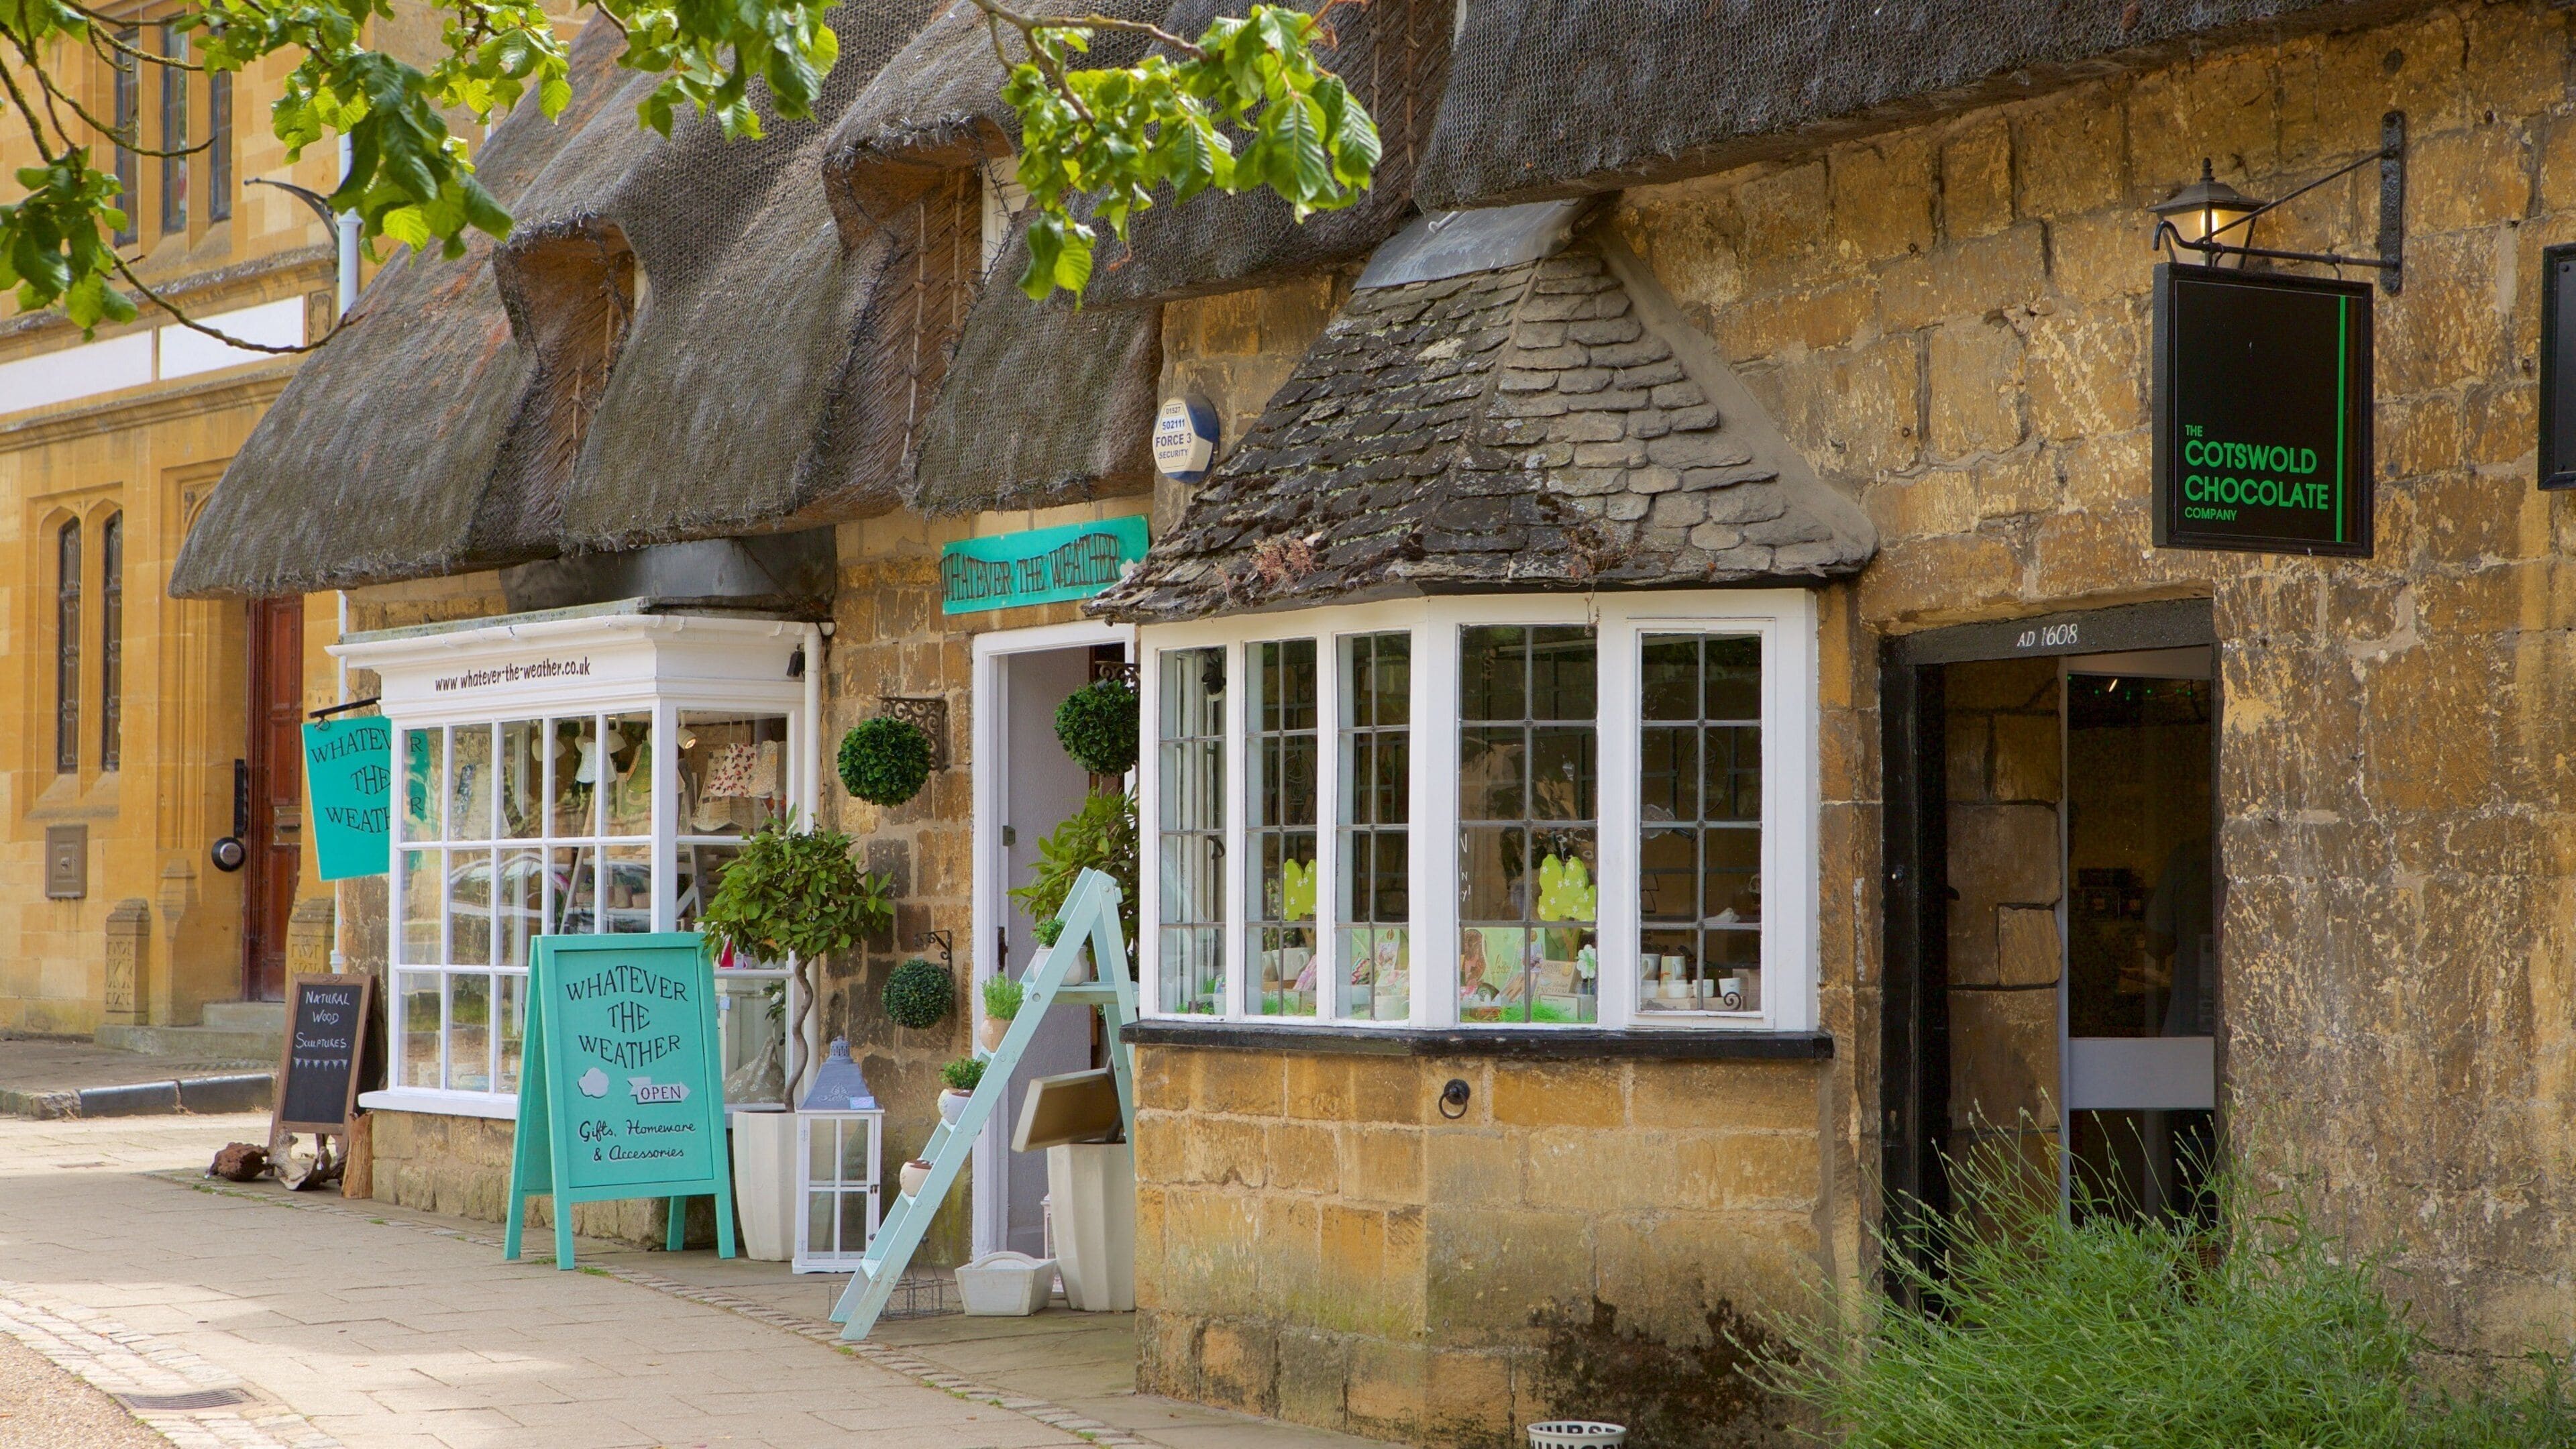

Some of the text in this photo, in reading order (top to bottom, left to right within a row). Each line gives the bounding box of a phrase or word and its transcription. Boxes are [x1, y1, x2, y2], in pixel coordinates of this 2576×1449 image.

[1162, 419, 1185, 430] 502111
[2185, 425, 2203, 437] THE
[1155, 433, 1191, 447] FORCE 3
[1159, 449, 1188, 460] SECURITY
[2184, 439, 2317, 474] COTSWOLD
[2184, 475, 2328, 510] CHOCOLATE
[2184, 506, 2237, 521] COMPANY
[939, 533, 1120, 602] WHATEVER THE WEATHER
[2017, 623, 2078, 647] AD 1608
[566, 965, 688, 1002] WHATEVER
[607, 1001, 650, 1033] THE
[578, 1034, 680, 1069] WEATHER
[641, 1085, 682, 1100] OPEN
[626, 1119, 696, 1136] Homeware
[594, 1144, 684, 1162] & Accessories
